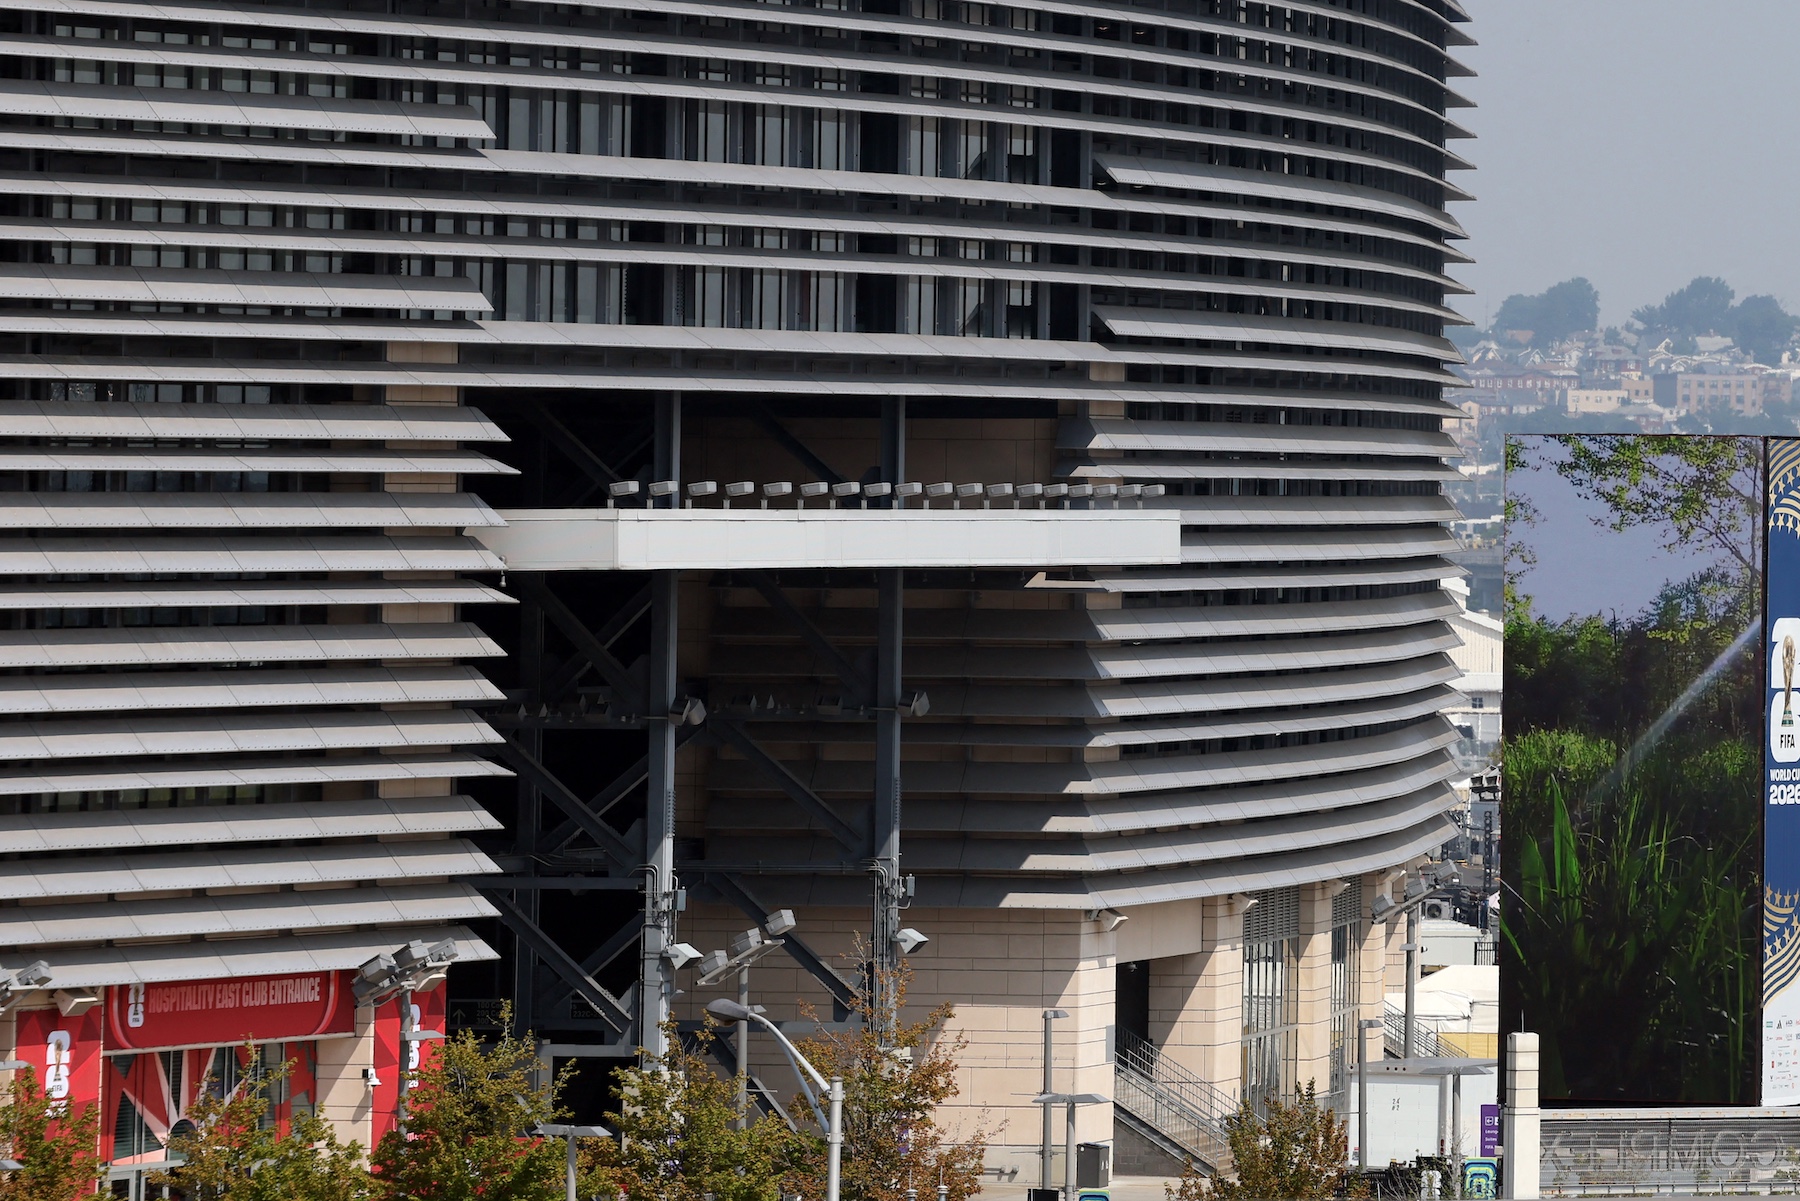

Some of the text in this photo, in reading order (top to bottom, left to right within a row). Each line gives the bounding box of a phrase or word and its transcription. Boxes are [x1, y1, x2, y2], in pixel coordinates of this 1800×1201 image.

[1780, 734, 1795, 748] FIFA
[1770, 769, 1792, 781] WORLD
[149, 977, 320, 1013] HOSPITALITY EAST CLUB ENTRANCE
